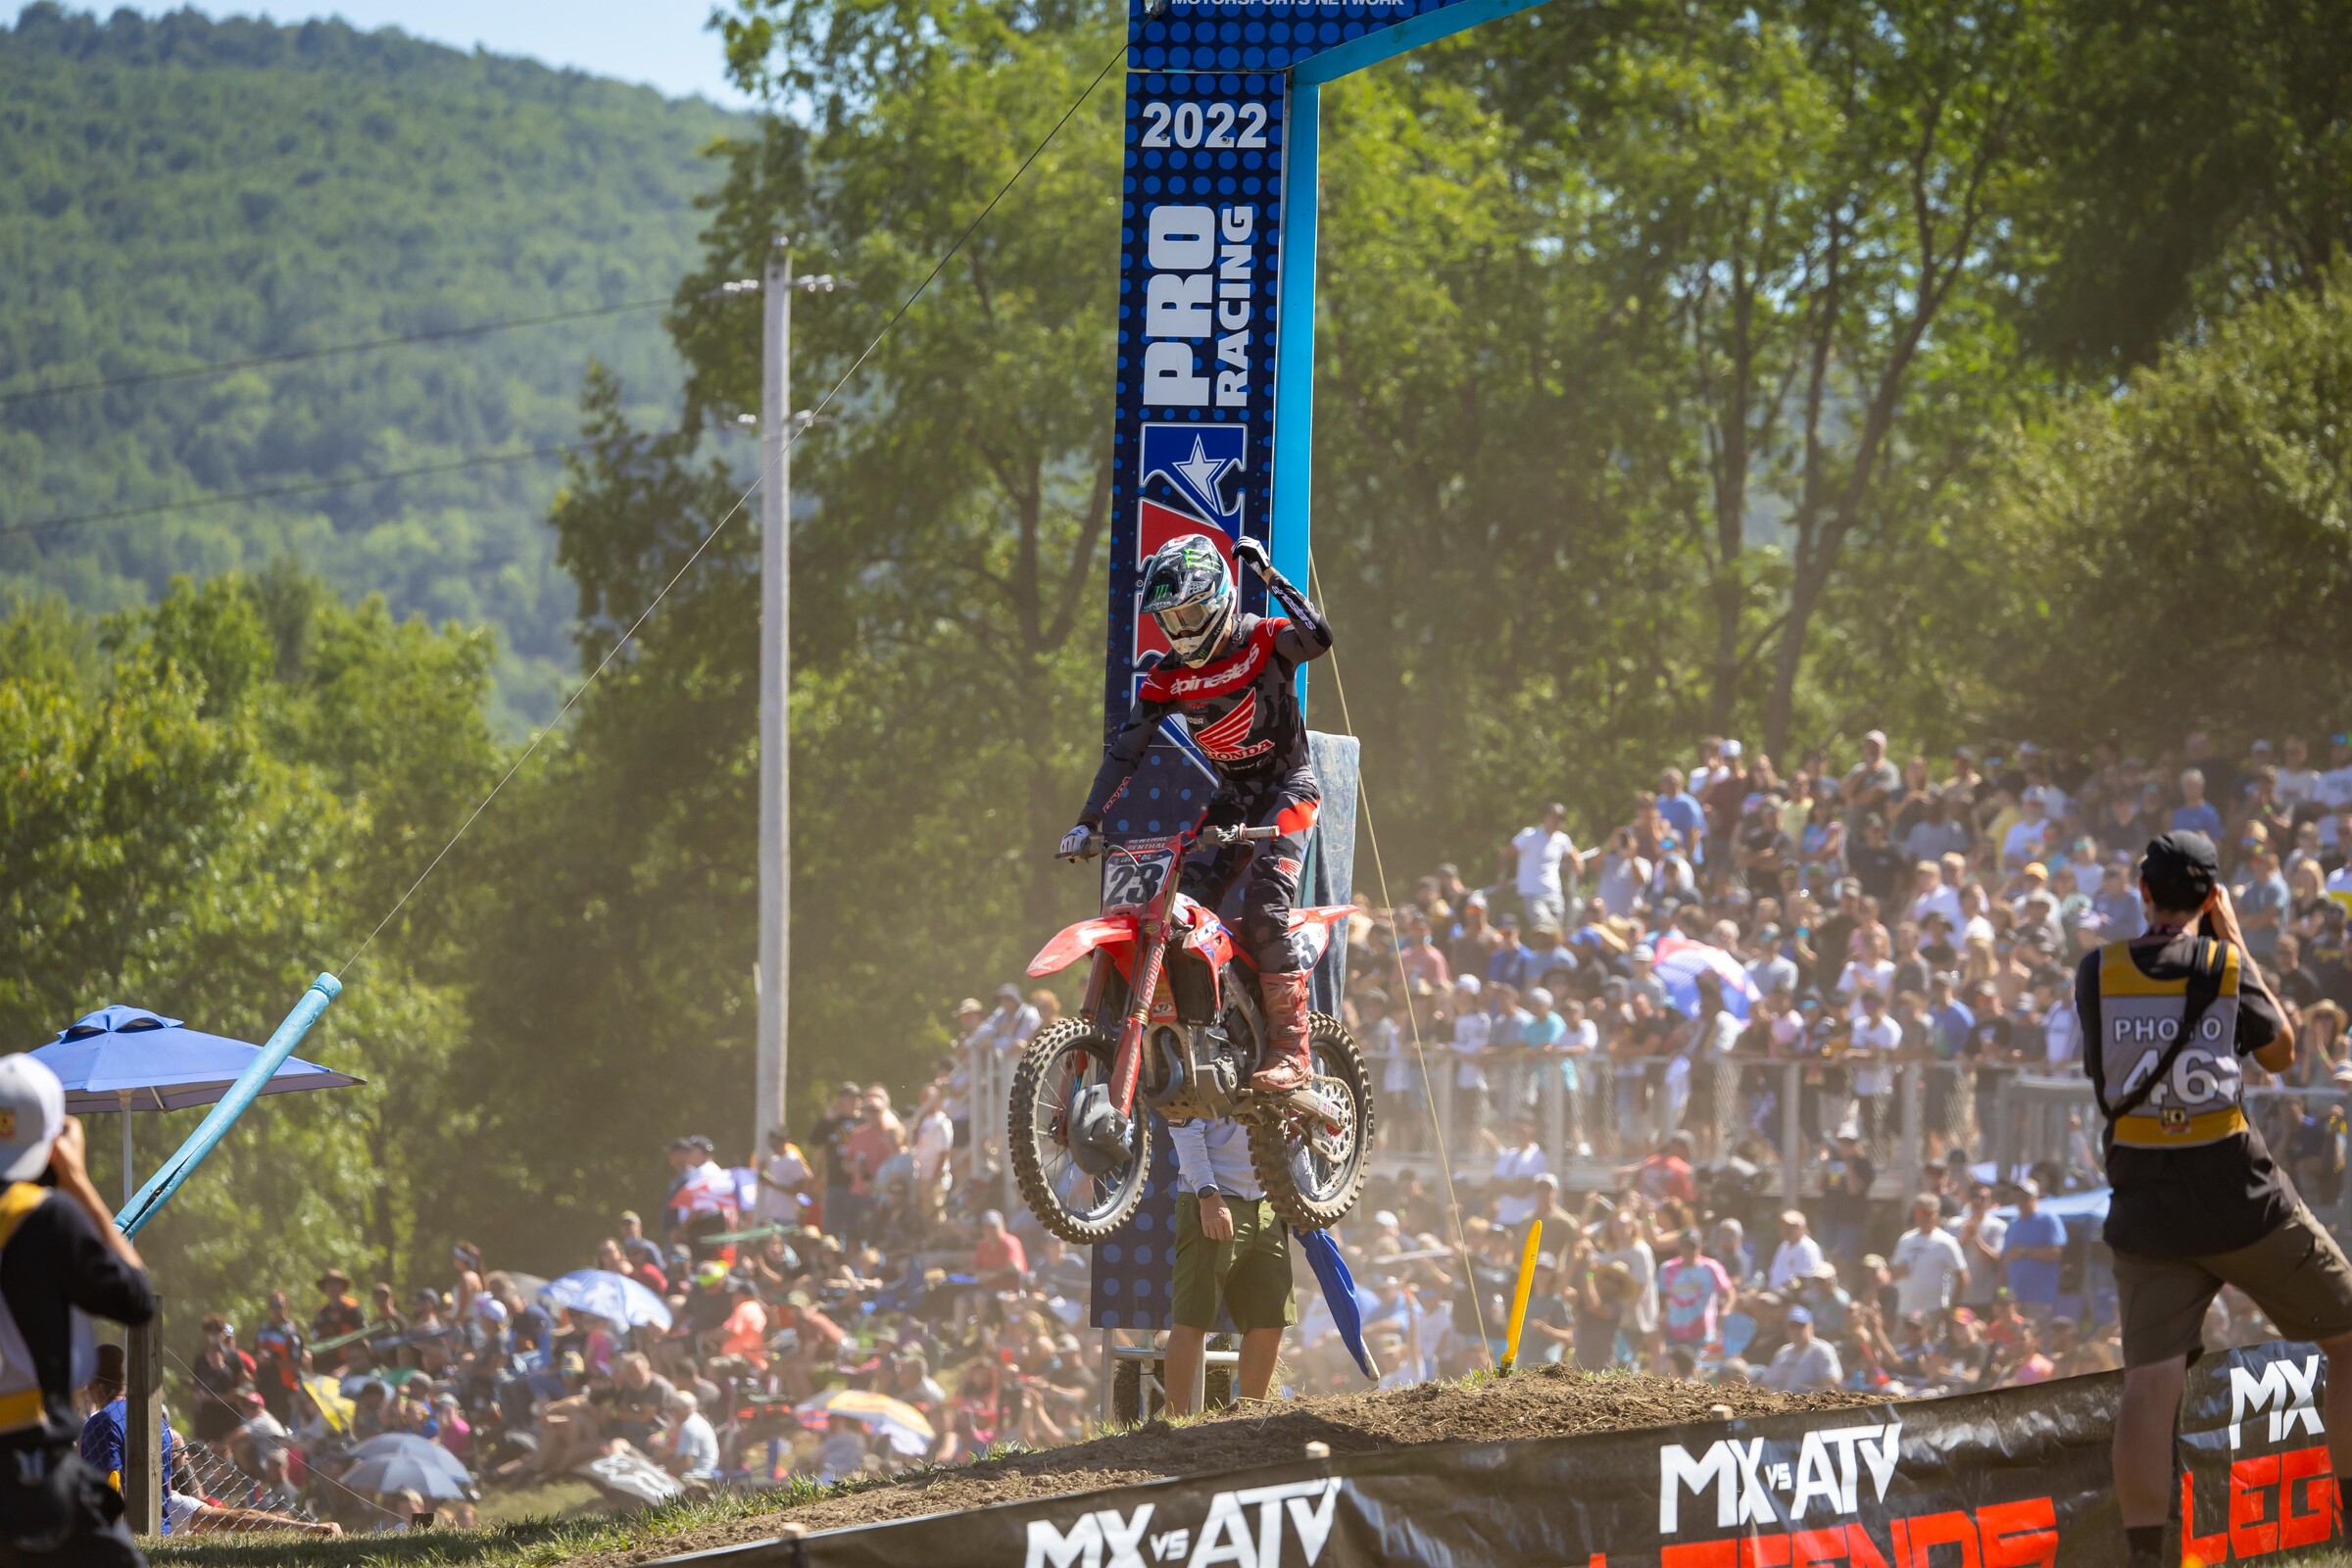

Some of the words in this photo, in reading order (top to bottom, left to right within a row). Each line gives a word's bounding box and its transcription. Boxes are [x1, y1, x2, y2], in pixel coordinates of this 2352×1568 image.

[1141, 102, 1267, 148] 2022
[1143, 205, 1215, 407] PRO
[1215, 206, 1253, 407] RACING
[1102, 776, 1132, 813] ONDA
[1127, 843, 1166, 852] RENTHAL
[1104, 863, 1163, 907] 23
[1142, 946, 1163, 1002] SHOWA
[2122, 1049, 2219, 1104] 46
[2228, 1354, 2326, 1450] MX
[1659, 1437, 1779, 1534] MX
[1789, 1422, 1902, 1521] ATV
[2180, 1444, 2344, 1568] LEG
[1024, 1502, 1156, 1568] MX
[1186, 1476, 1343, 1568] ATV
